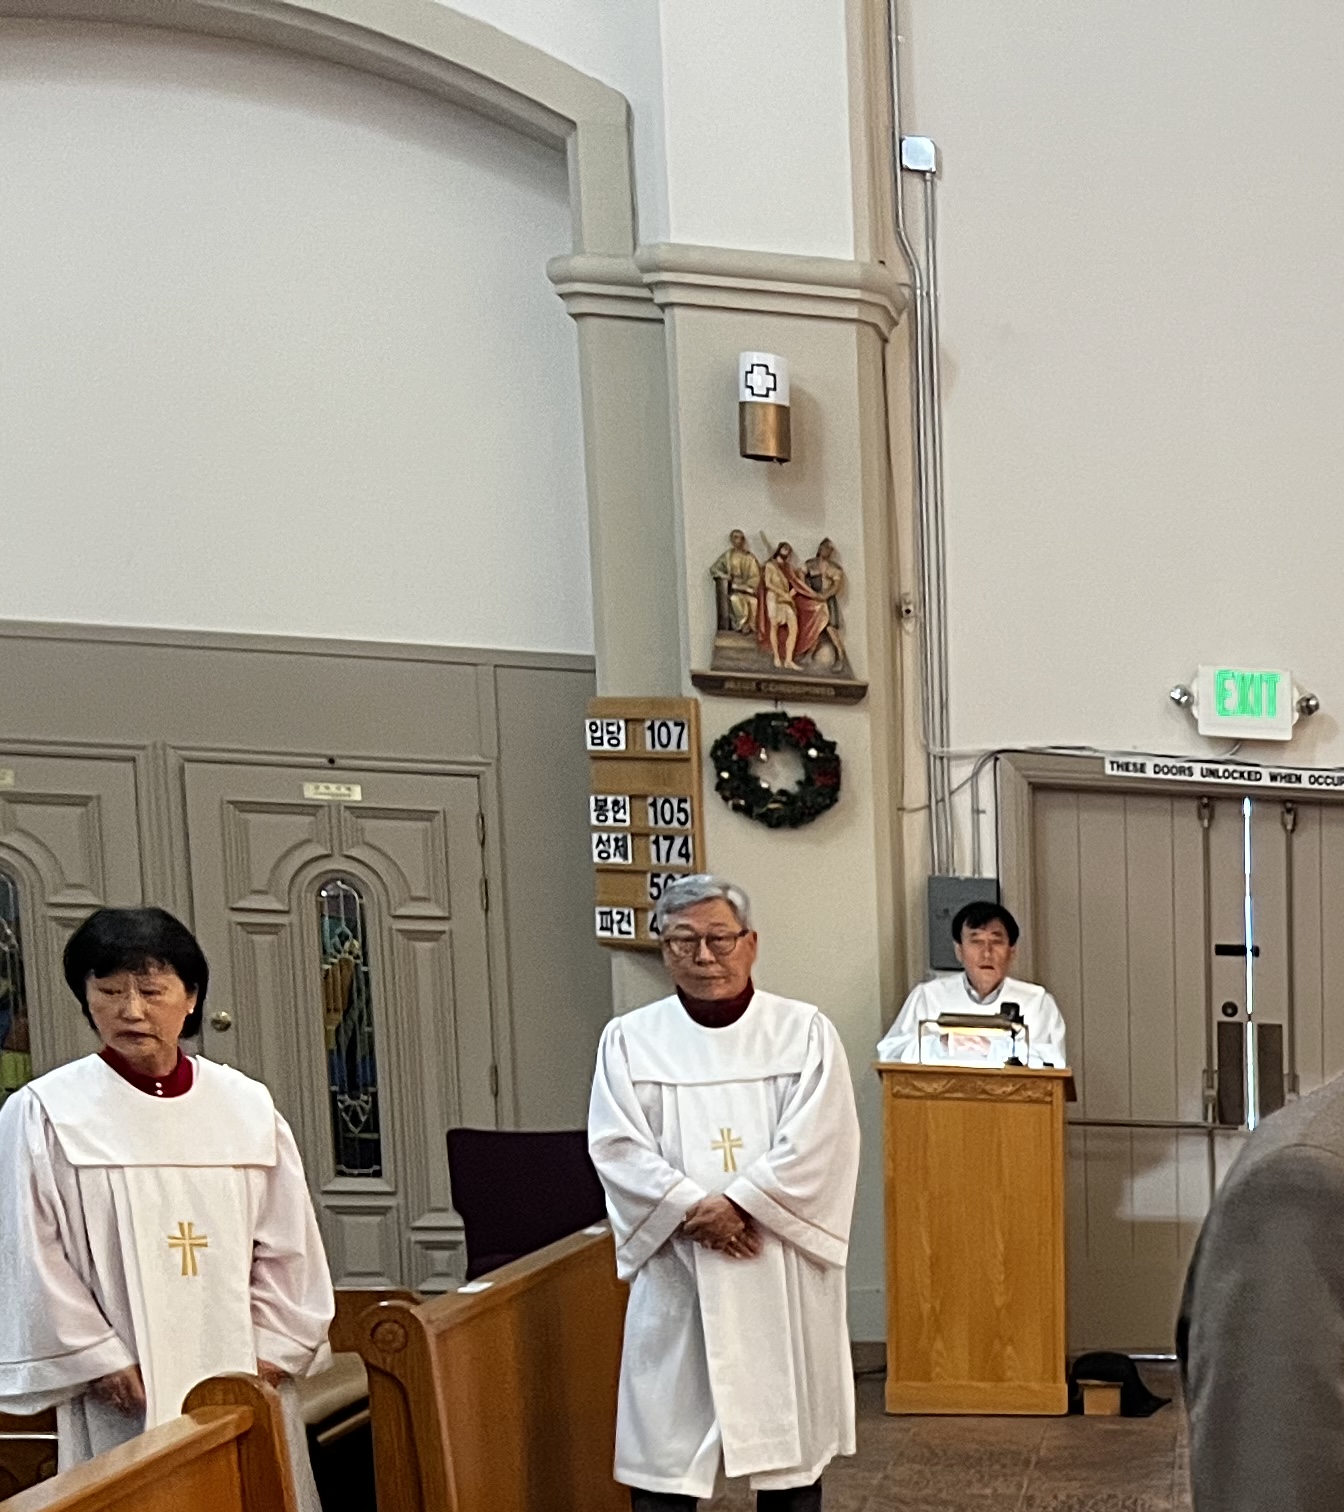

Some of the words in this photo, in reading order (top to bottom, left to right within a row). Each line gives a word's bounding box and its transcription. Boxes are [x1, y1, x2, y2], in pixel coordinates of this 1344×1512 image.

[1216, 669, 1280, 718] EXIT
[589, 721, 621, 747] 입당
[647, 720, 685, 749] 107
[1110, 761, 1147, 774] THESE
[1153, 763, 1194, 777] DOORS
[1201, 766, 1262, 781] UNLOCKED
[1269, 771, 1302, 784] WHEN
[593, 796, 627, 823] 봉헌
[648, 796, 689, 826] 105
[652, 834, 690, 864] 174
